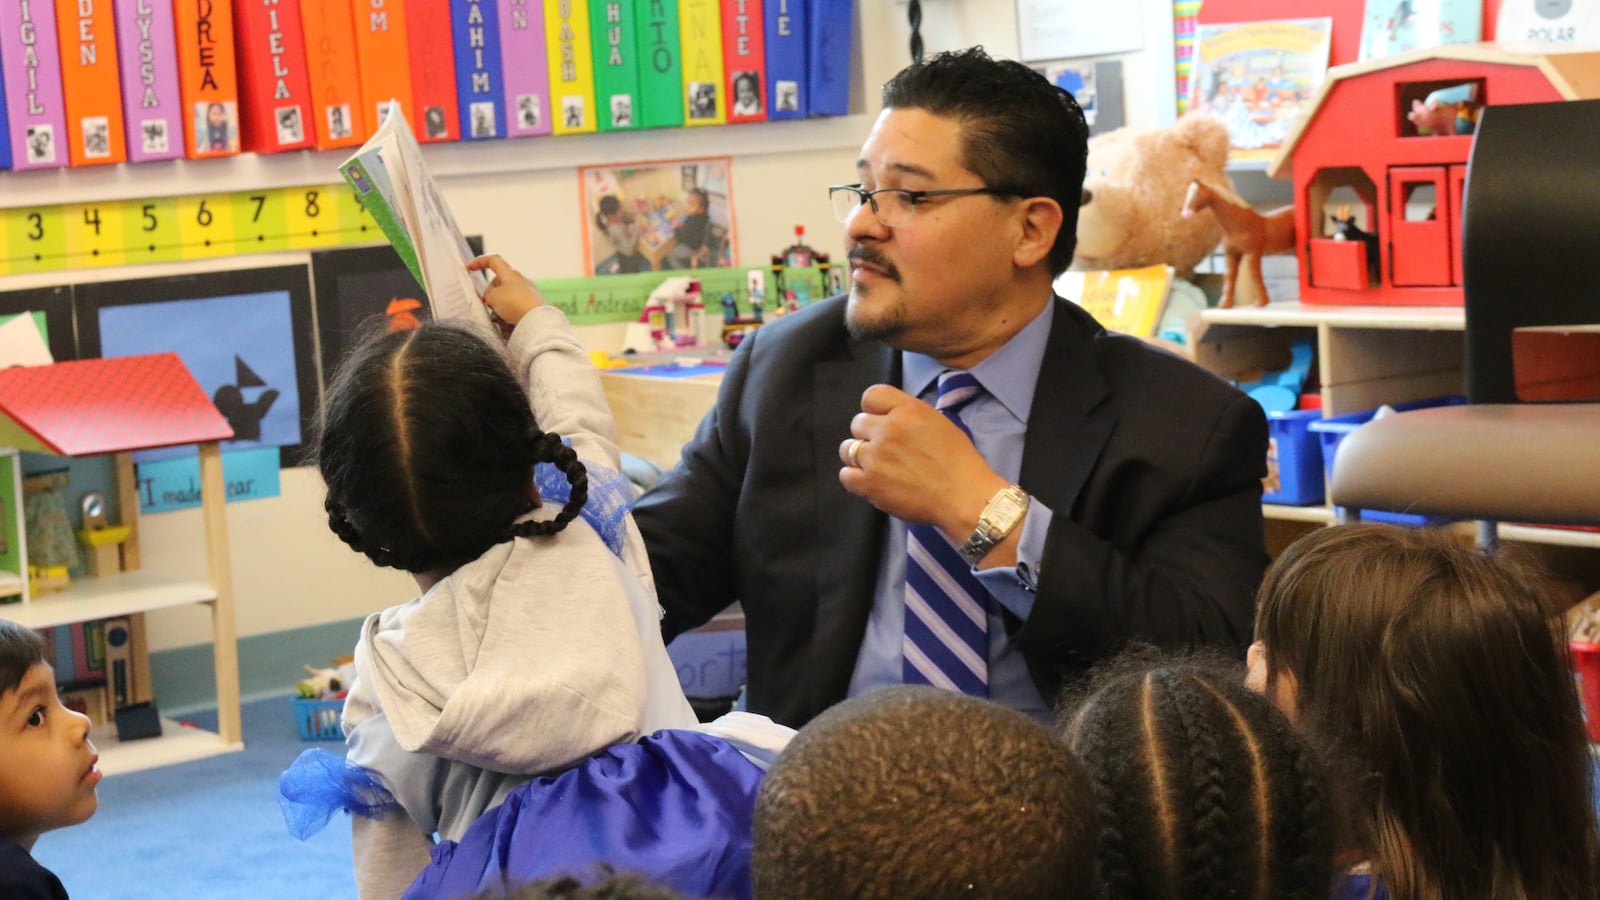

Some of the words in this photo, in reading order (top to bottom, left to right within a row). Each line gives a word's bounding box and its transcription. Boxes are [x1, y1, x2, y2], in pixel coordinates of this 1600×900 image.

[19, 0, 45, 116] IGAIL
[77, 0, 98, 66] DEN
[136, 0, 159, 108] LYSSA
[197, 0, 218, 91] DREA
[263, 0, 291, 100] IELA
[466, 0, 490, 93] AHIM
[606, 2, 623, 66] HUA
[1527, 26, 1576, 42] POLAR
[27, 213, 44, 241] 3
[84, 208, 102, 235] 4
[141, 205, 157, 232] 5
[197, 201, 213, 226] 6
[249, 196, 266, 222] 7
[305, 192, 320, 217] 8
